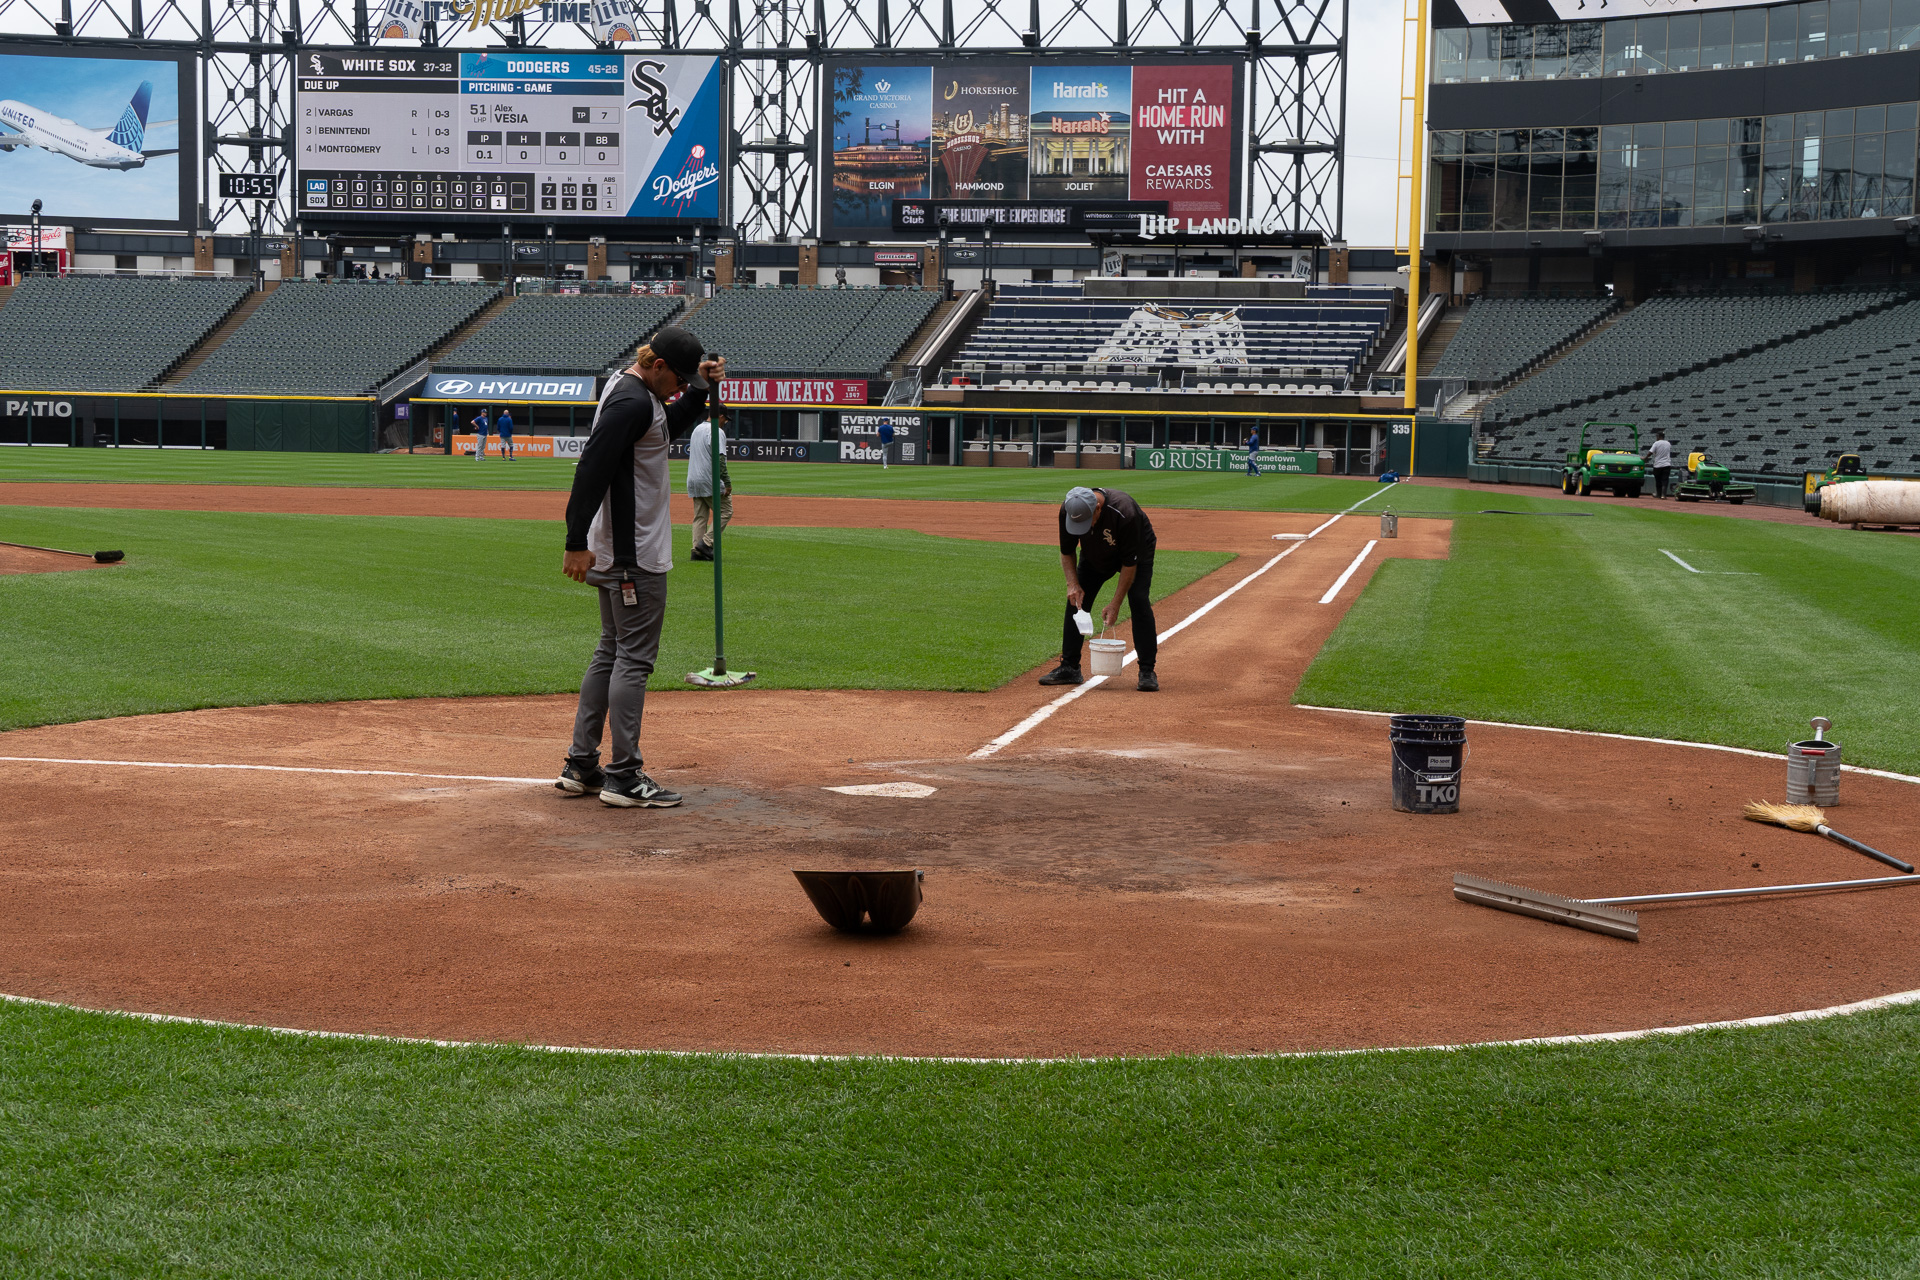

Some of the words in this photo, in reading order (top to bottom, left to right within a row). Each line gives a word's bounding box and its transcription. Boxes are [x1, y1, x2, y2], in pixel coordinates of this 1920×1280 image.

[423, 1, 460, 22] IT'S
[540, 2, 592, 23] TIME
[594, 0, 628, 26] Lite
[342, 59, 384, 72] WHITE
[388, 60, 416, 72] SOX
[423, 63, 452, 72] 37-32
[507, 61, 570, 74] DODGERS
[588, 65, 618, 74] 45-26
[304, 80, 323, 90] DUE
[326, 80, 340, 90] UP
[468, 82, 514, 92] PITCHING
[524, 84, 552, 92] GAME
[961, 86, 1018, 95] HORSESHOE
[1158, 88, 1188, 103] HIT
[1192, 88, 1207, 103] A
[470, 104, 486, 115] 51
[1, 106, 35, 128] UNITED
[494, 114, 528, 123] VESIA
[1139, 106, 1185, 128] HOME
[1190, 105, 1224, 128] RUN
[946, 136, 980, 149] HORSESHOE
[1157, 130, 1204, 144] WITH
[476, 150, 493, 159] 0.1
[520, 151, 528, 160] 0
[559, 152, 567, 160] 0
[598, 152, 606, 160] 0
[1146, 165, 1212, 177] CAESARS
[229, 178, 273, 194] 10:55
[652, 163, 719, 200] Dodgers
[869, 182, 895, 190] ELGIN
[955, 182, 1004, 190] HAMMOND
[1065, 183, 1094, 191] JOLIET
[1146, 179, 1212, 190] REWARDS
[564, 186, 576, 194] 10
[587, 186, 593, 194] 1
[606, 186, 612, 194] 1
[586, 200, 593, 208] 0
[606, 201, 612, 209] 1
[902, 206, 925, 215] Rate
[1010, 209, 1066, 223] EXPERIENCE
[902, 216, 924, 224] Club
[1138, 214, 1180, 240] Lite
[1188, 218, 1276, 235] LANDING
[1105, 260, 1120, 272] Lite
[478, 381, 583, 396] HYUNDAI
[776, 381, 835, 402] MEATS
[6, 401, 72, 417] PATIO
[841, 426, 909, 436] WELLSS
[1393, 425, 1410, 434] 335
[456, 442, 478, 450] YOU
[528, 443, 551, 452] MVP
[757, 445, 795, 456] SHIFT
[840, 442, 882, 460] Rate
[1170, 453, 1221, 469] RUSH
[1230, 454, 1249, 462] Your
[1416, 785, 1457, 802] TKO
